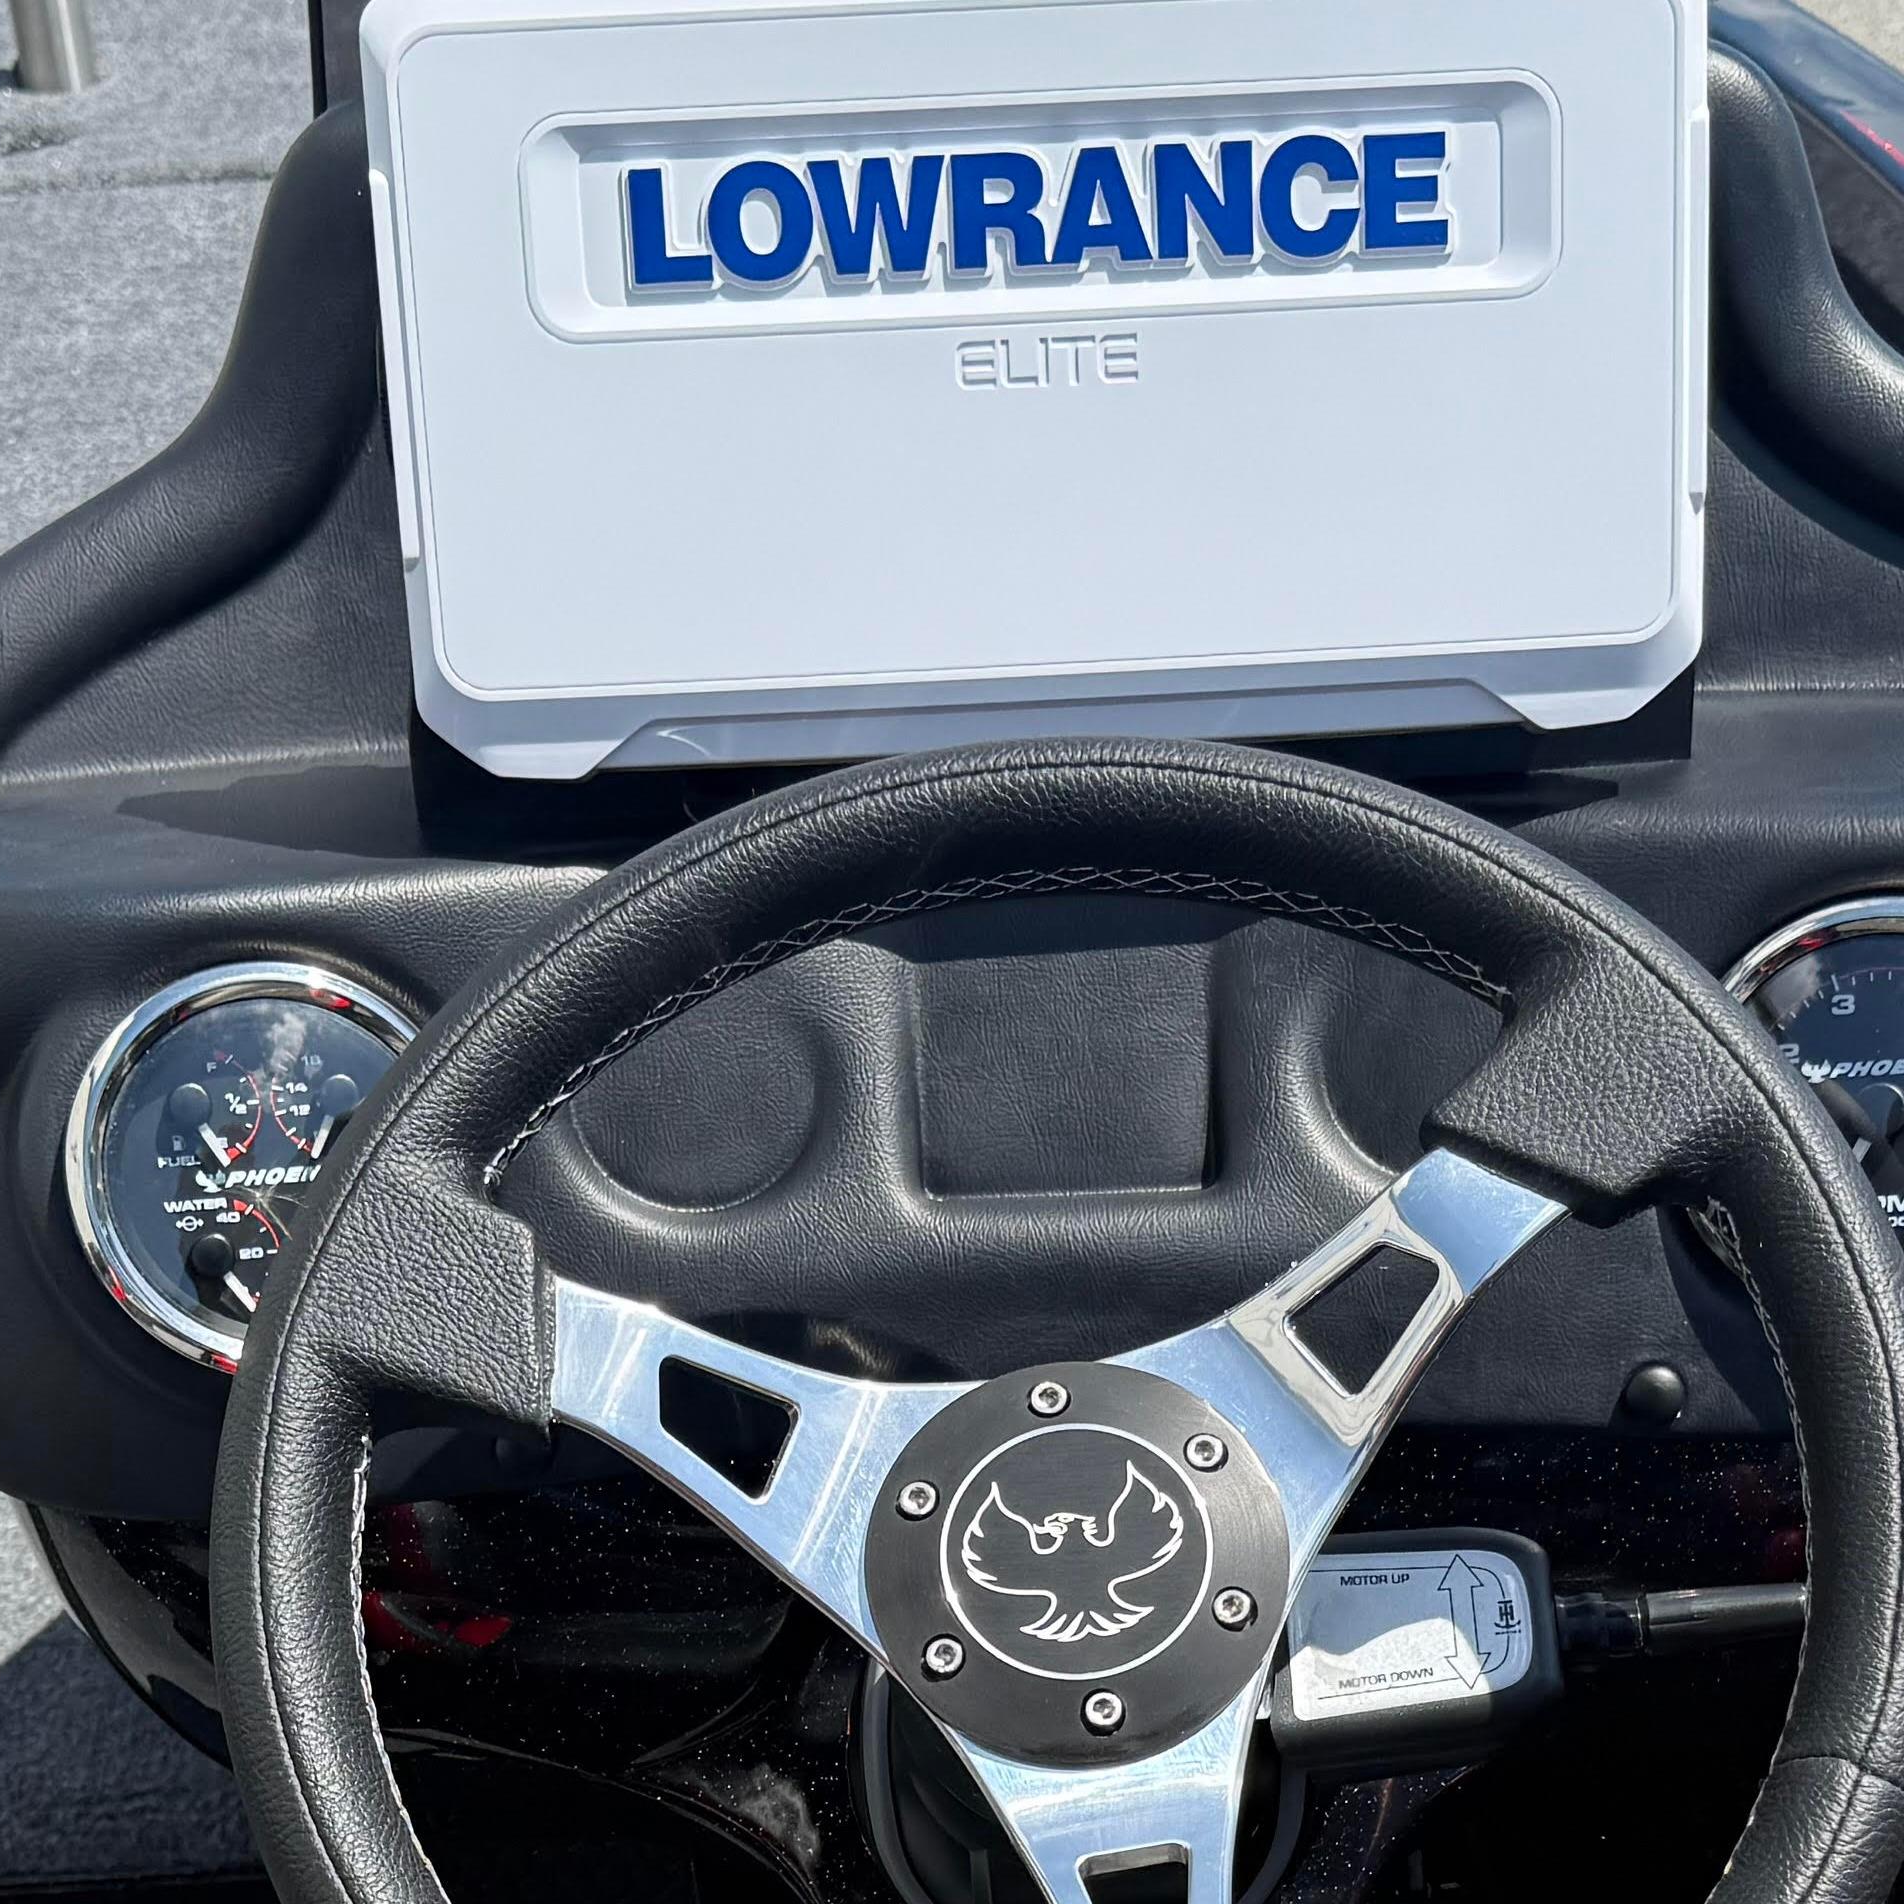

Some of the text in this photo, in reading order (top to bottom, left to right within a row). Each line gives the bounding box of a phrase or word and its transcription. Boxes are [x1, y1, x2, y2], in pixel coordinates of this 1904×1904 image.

[626, 130, 1450, 290] LOWRANCE
[955, 333, 1140, 391] ELITE
[1831, 994, 1855, 1015] 3
[206, 1062, 217, 1073] F
[157, 1155, 201, 1169] FUEL
[163, 1197, 228, 1213] WATER
[216, 1211, 241, 1223] 40
[239, 1247, 264, 1260] 20
[1340, 1573, 1410, 1587] MOTOR UP
[1339, 1667, 1434, 1689] MOTOR DOWN
